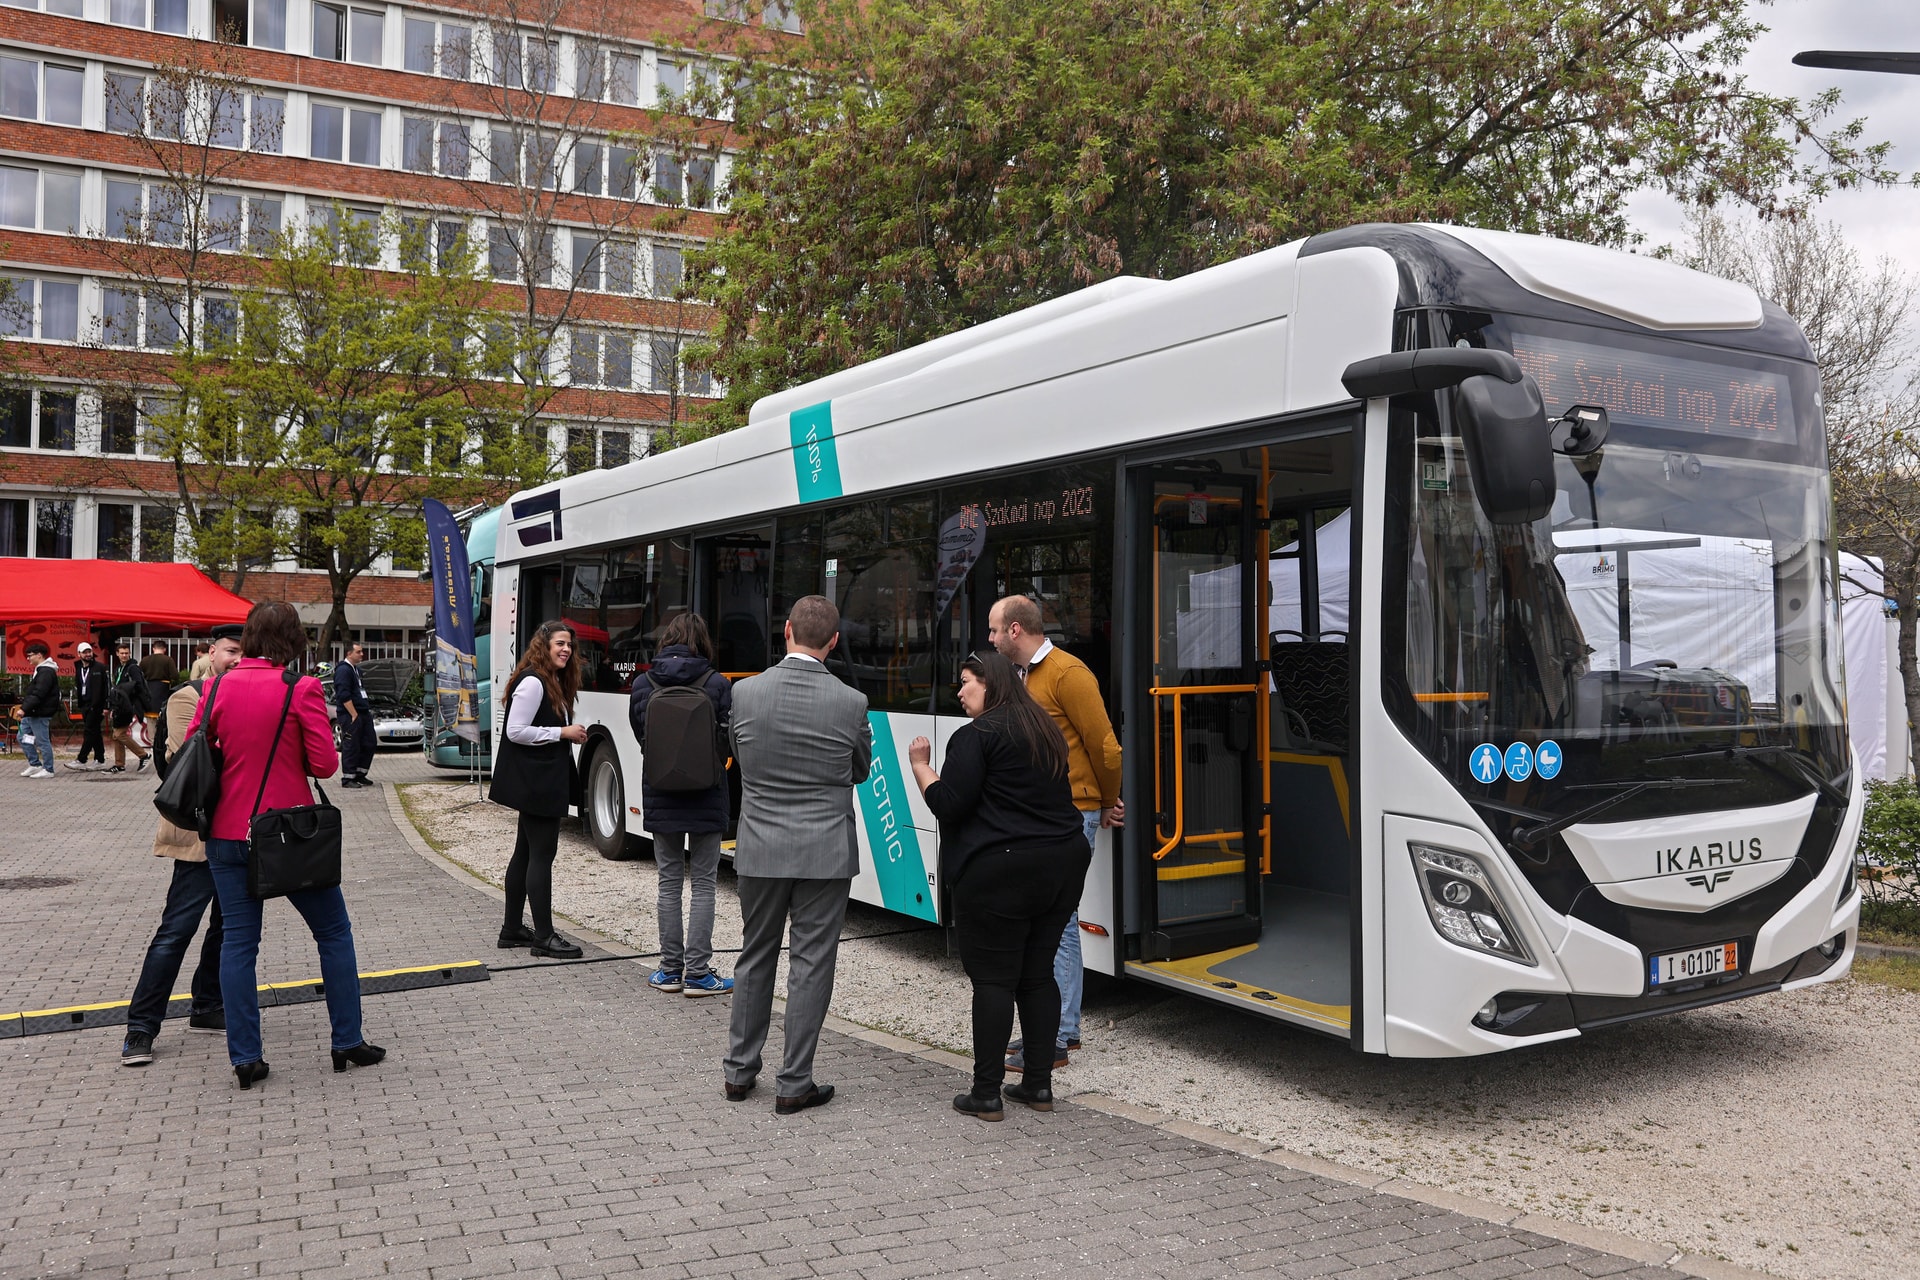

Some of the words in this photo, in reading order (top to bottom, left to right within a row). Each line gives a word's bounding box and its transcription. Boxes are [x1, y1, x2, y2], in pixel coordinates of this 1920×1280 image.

[1514, 349, 1559, 405] ME
[1574, 359, 1665, 417] Szakmai
[1678, 387, 1717, 433] nap
[1728, 381, 1778, 431] 2023
[806, 423, 822, 484] 100%
[984, 498, 1028, 527] Szakmai
[1033, 500, 1056, 525] nap
[1062, 486, 1093, 517] 2023
[1592, 564, 1615, 574] BRIMO
[613, 662, 636, 672] IKARUS
[868, 721, 903, 864] ECTRIC
[1656, 837, 1762, 874] IKARUS
[1725, 950, 1736, 965] 22
